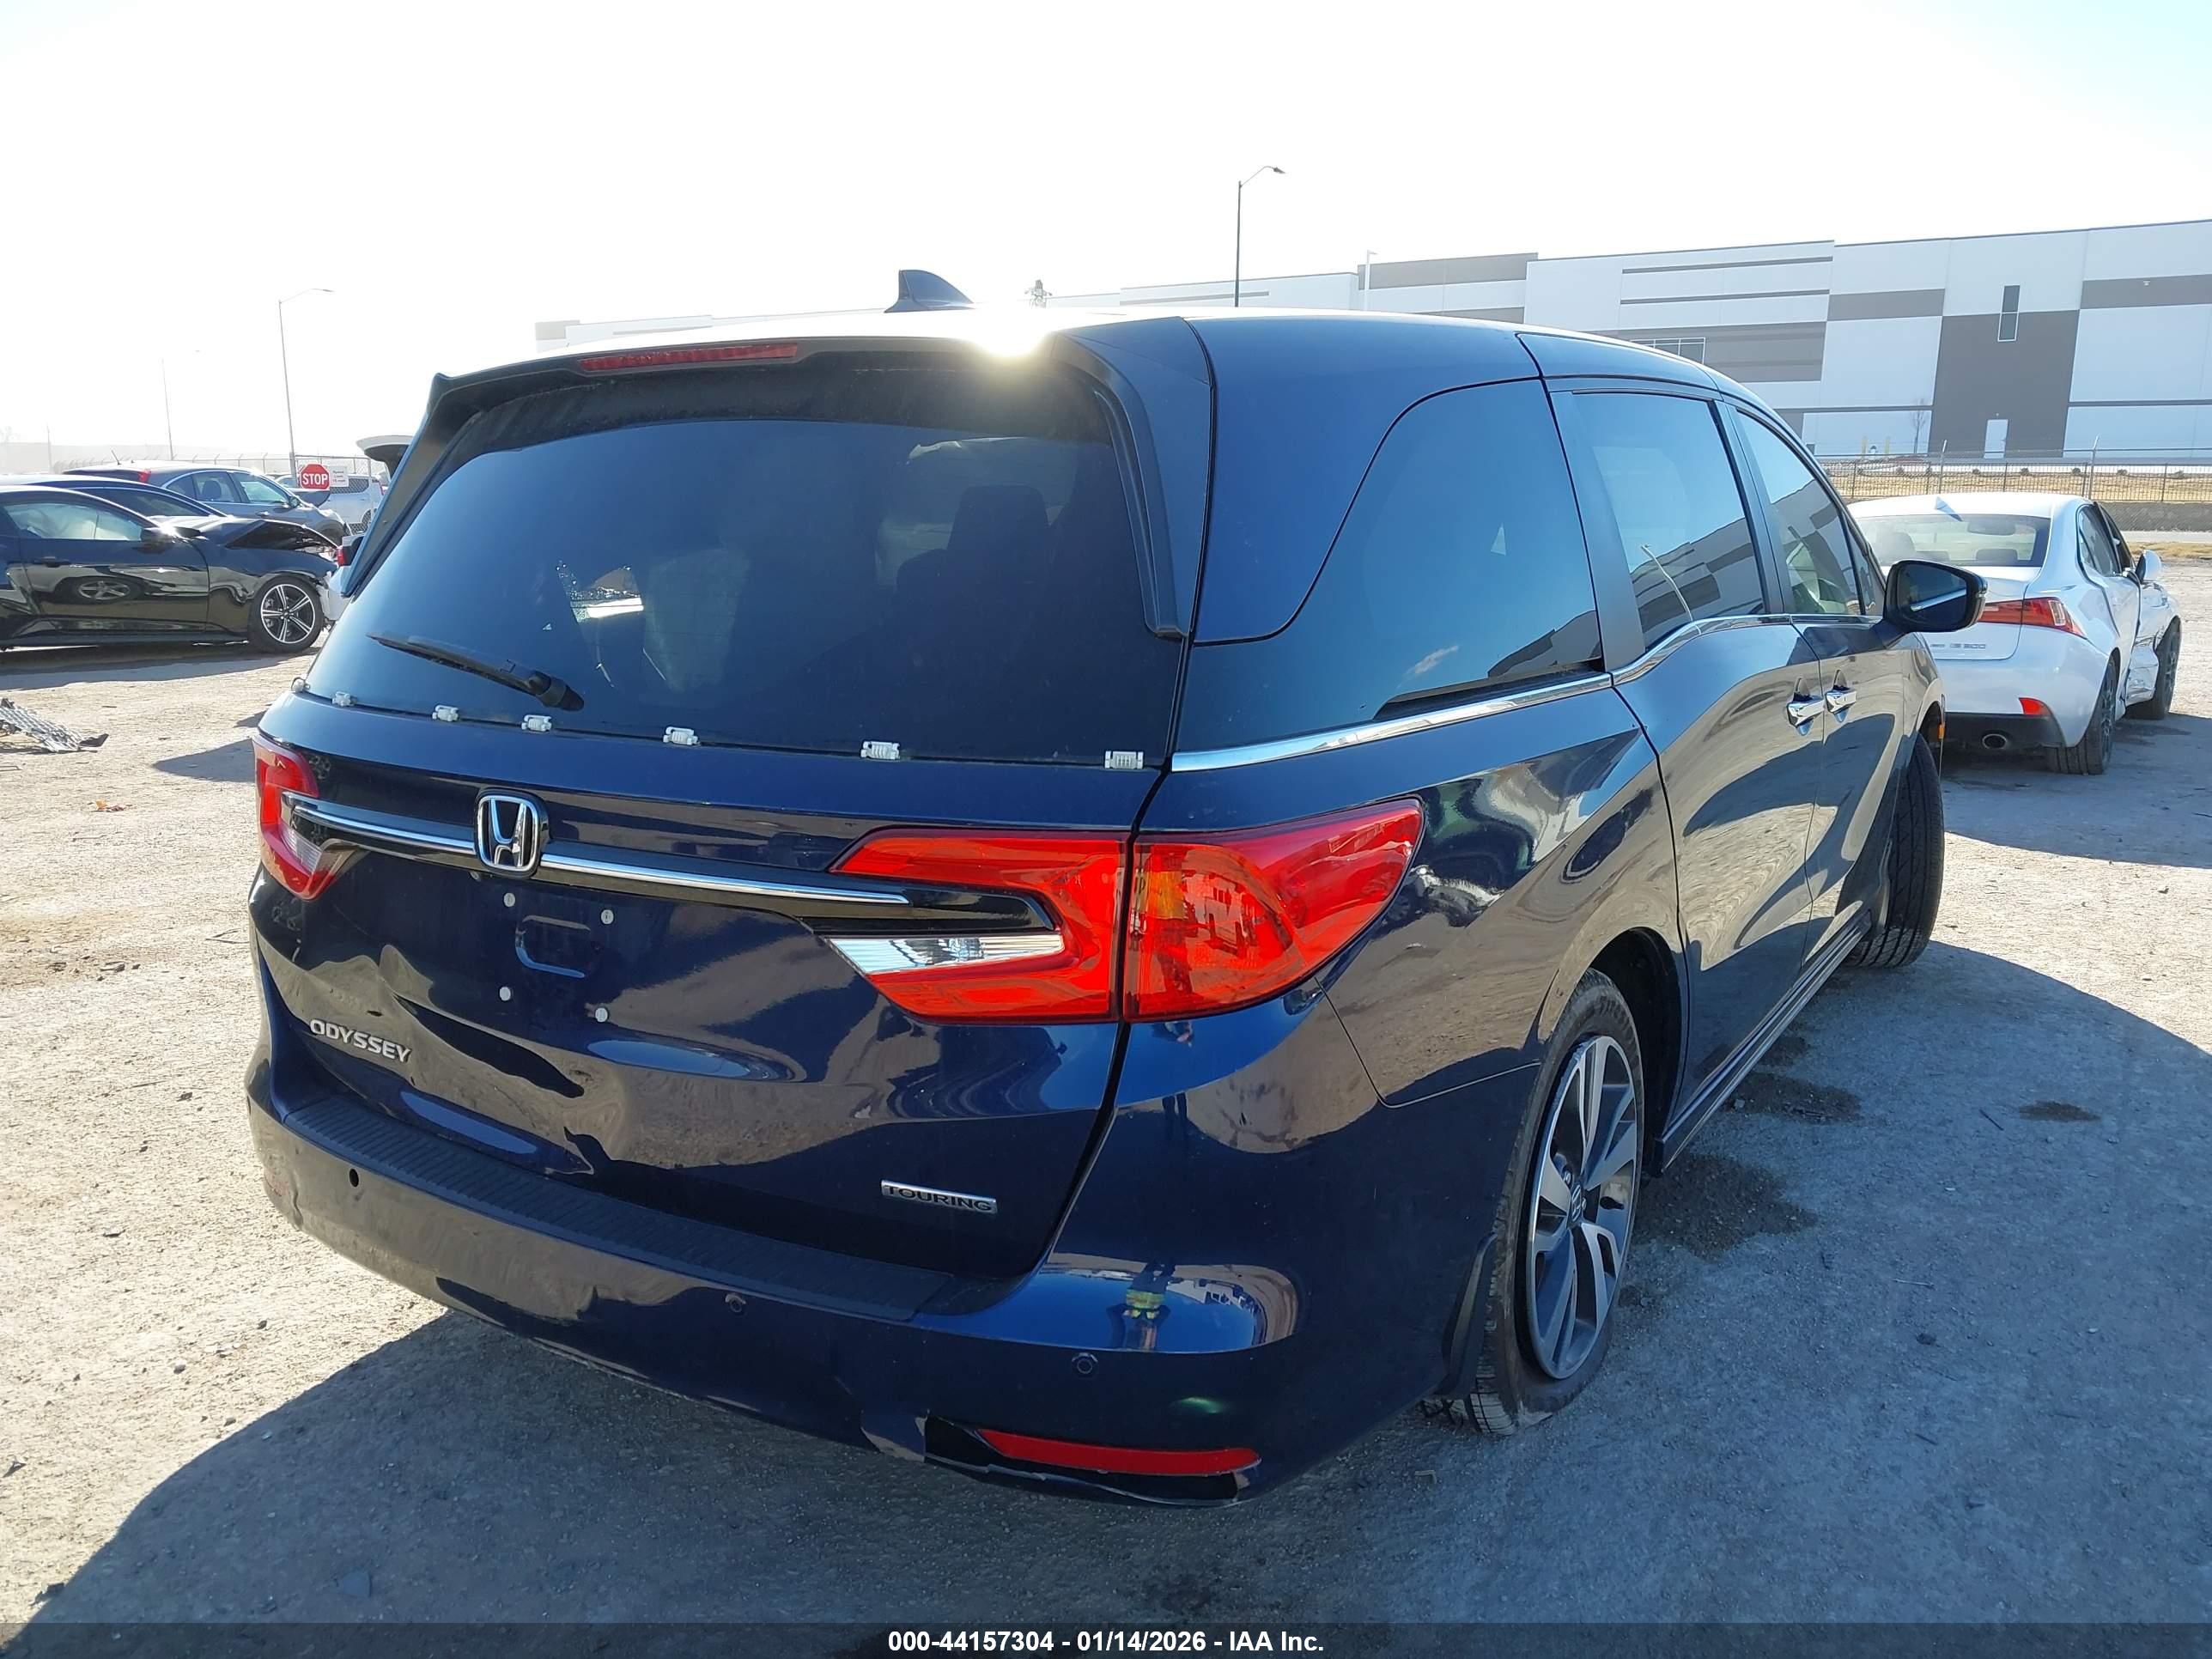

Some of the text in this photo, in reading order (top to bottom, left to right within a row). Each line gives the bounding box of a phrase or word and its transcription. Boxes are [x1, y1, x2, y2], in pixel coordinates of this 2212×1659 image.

[302, 473, 328, 485] STOP
[309, 1018, 411, 1063] ODYSSEY
[883, 1184, 993, 1212] TOURING
